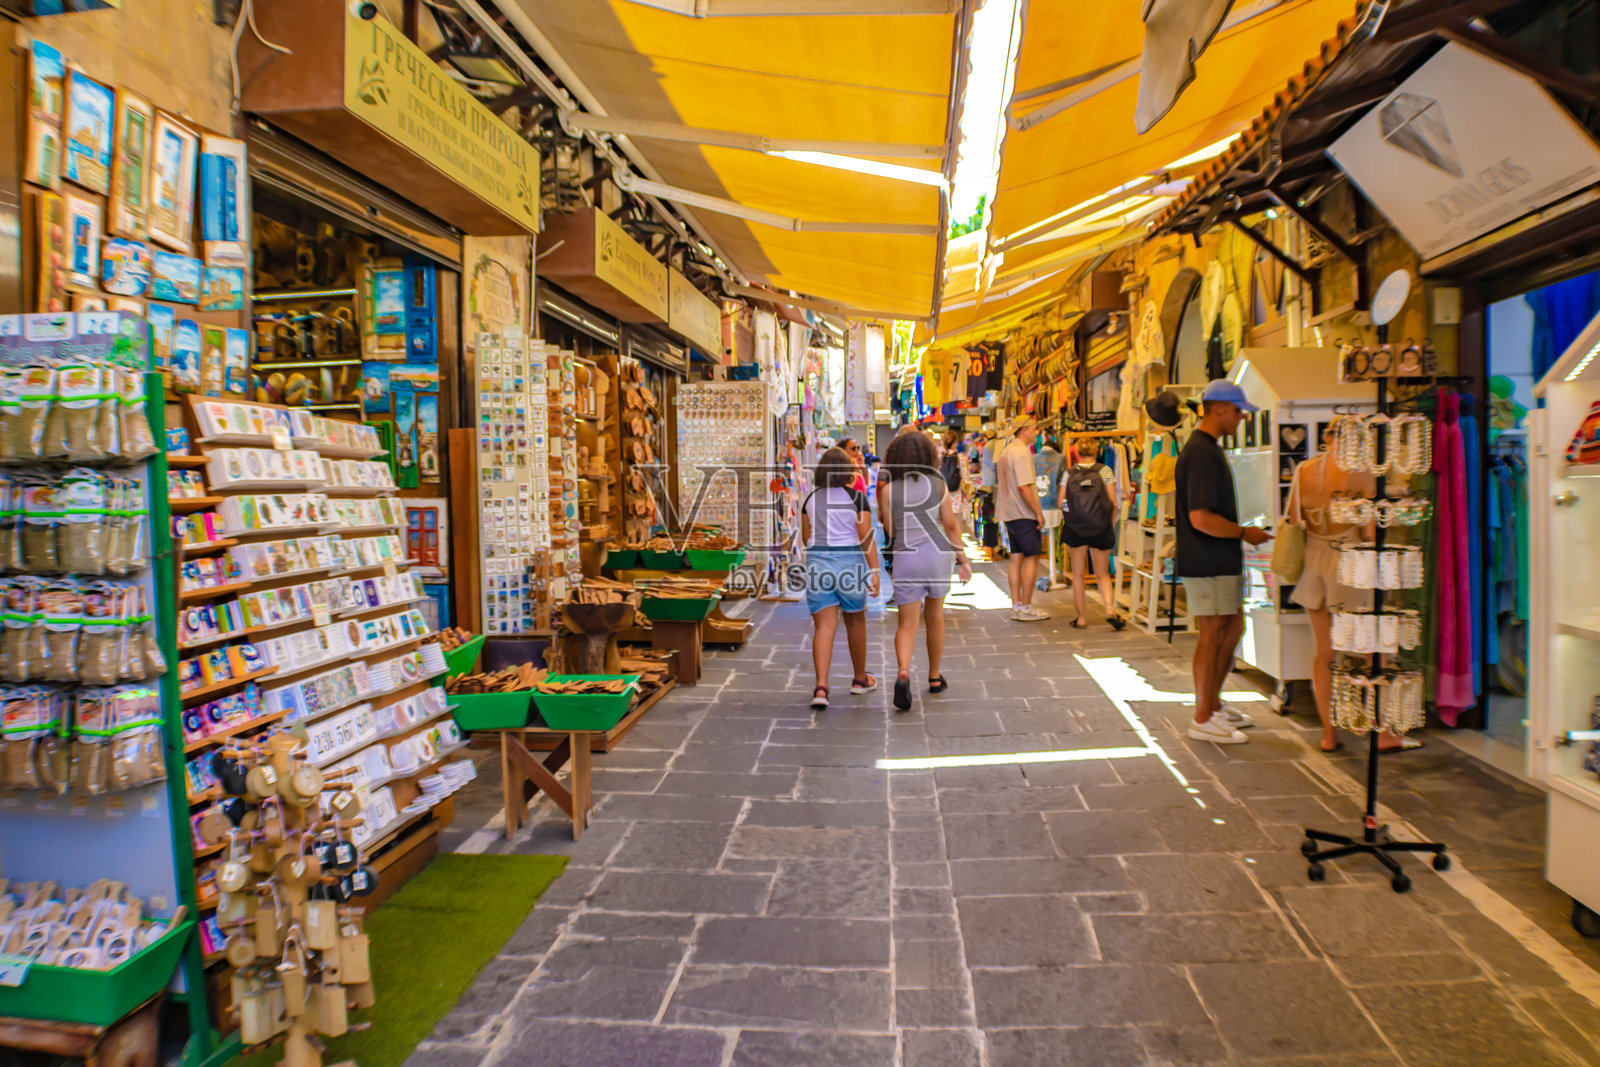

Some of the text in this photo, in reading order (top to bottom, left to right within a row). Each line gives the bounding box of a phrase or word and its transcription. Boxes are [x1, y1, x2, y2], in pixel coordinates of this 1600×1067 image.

[371, 23, 526, 174] ГРЕЧЕСКАЯ ПРИРОДА
[953, 362, 960, 382] 7
